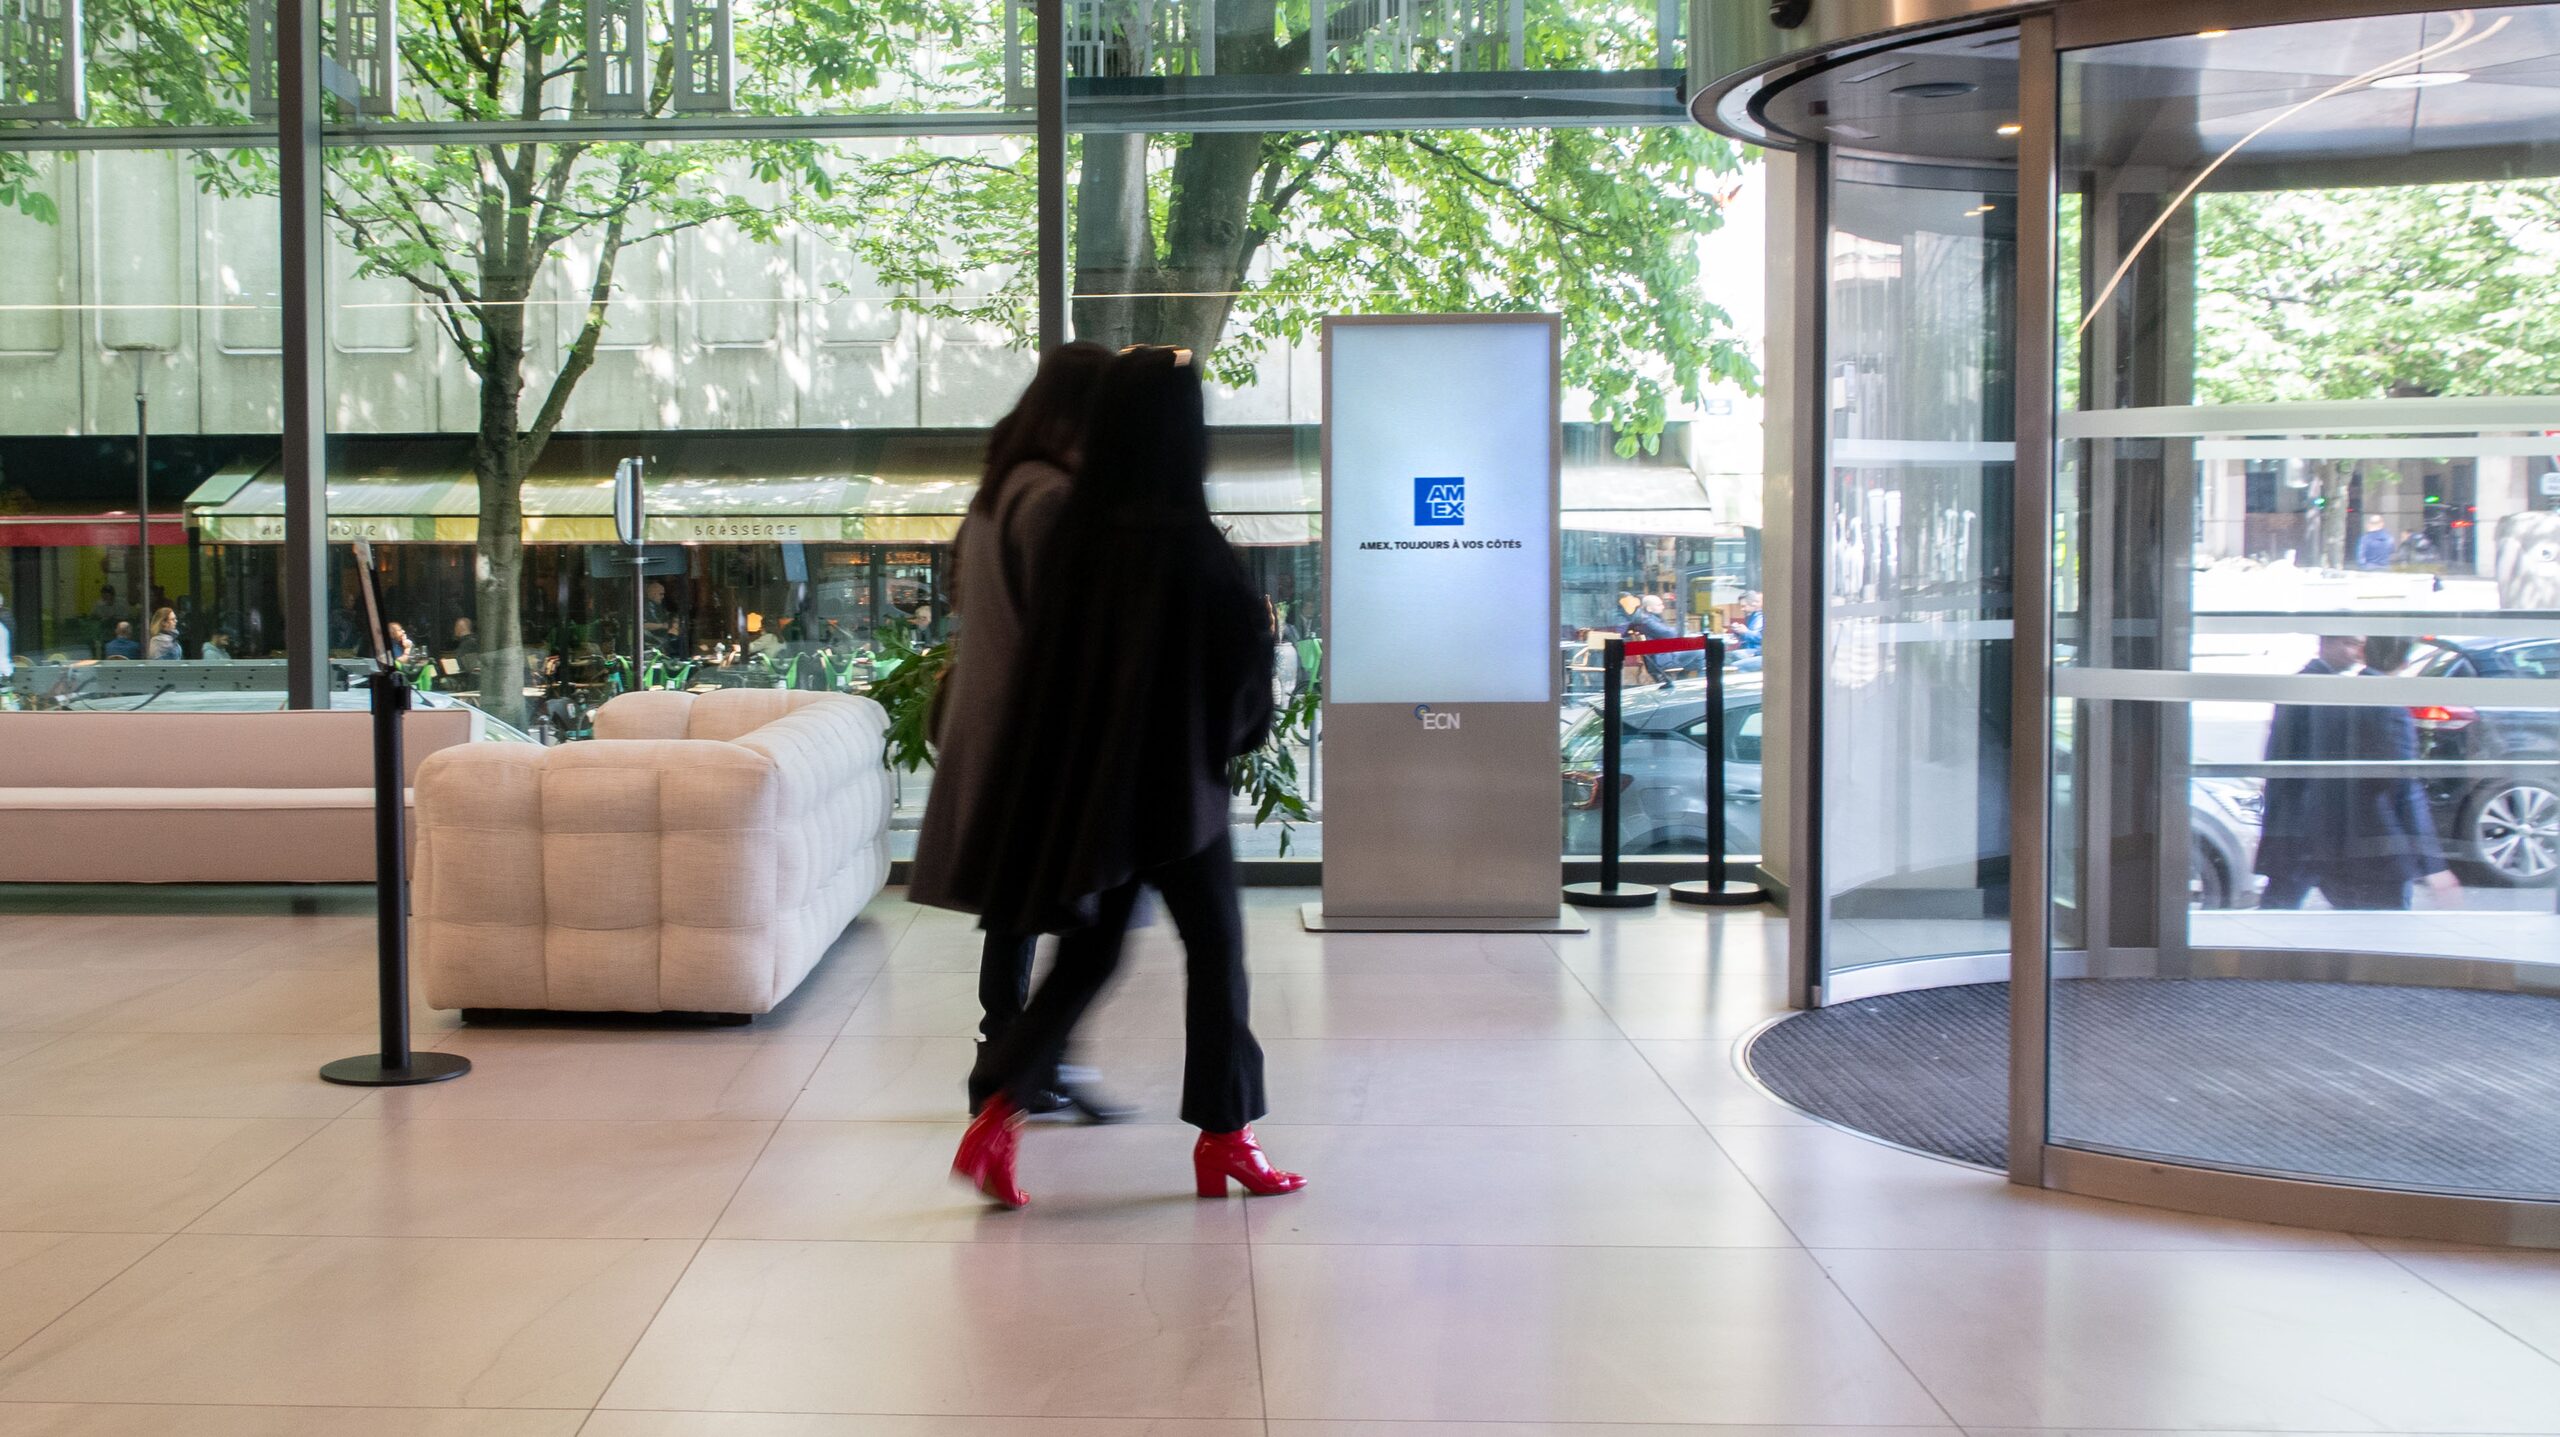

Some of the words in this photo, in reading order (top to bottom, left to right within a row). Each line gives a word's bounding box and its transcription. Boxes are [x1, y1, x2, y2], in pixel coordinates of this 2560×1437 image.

[1426, 485, 1464, 502] AM
[1432, 502, 1464, 518] EX
[330, 525, 377, 536] HOUR
[694, 525, 798, 536] BRASSERIE
[1359, 541, 1393, 551] AMEX,
[1395, 540, 1450, 550] TOUJOURS
[1452, 538, 1460, 549] À
[1462, 540, 1484, 549] VOS
[1486, 538, 1522, 549] CÔTÉS
[1423, 712, 1461, 730] ECN
